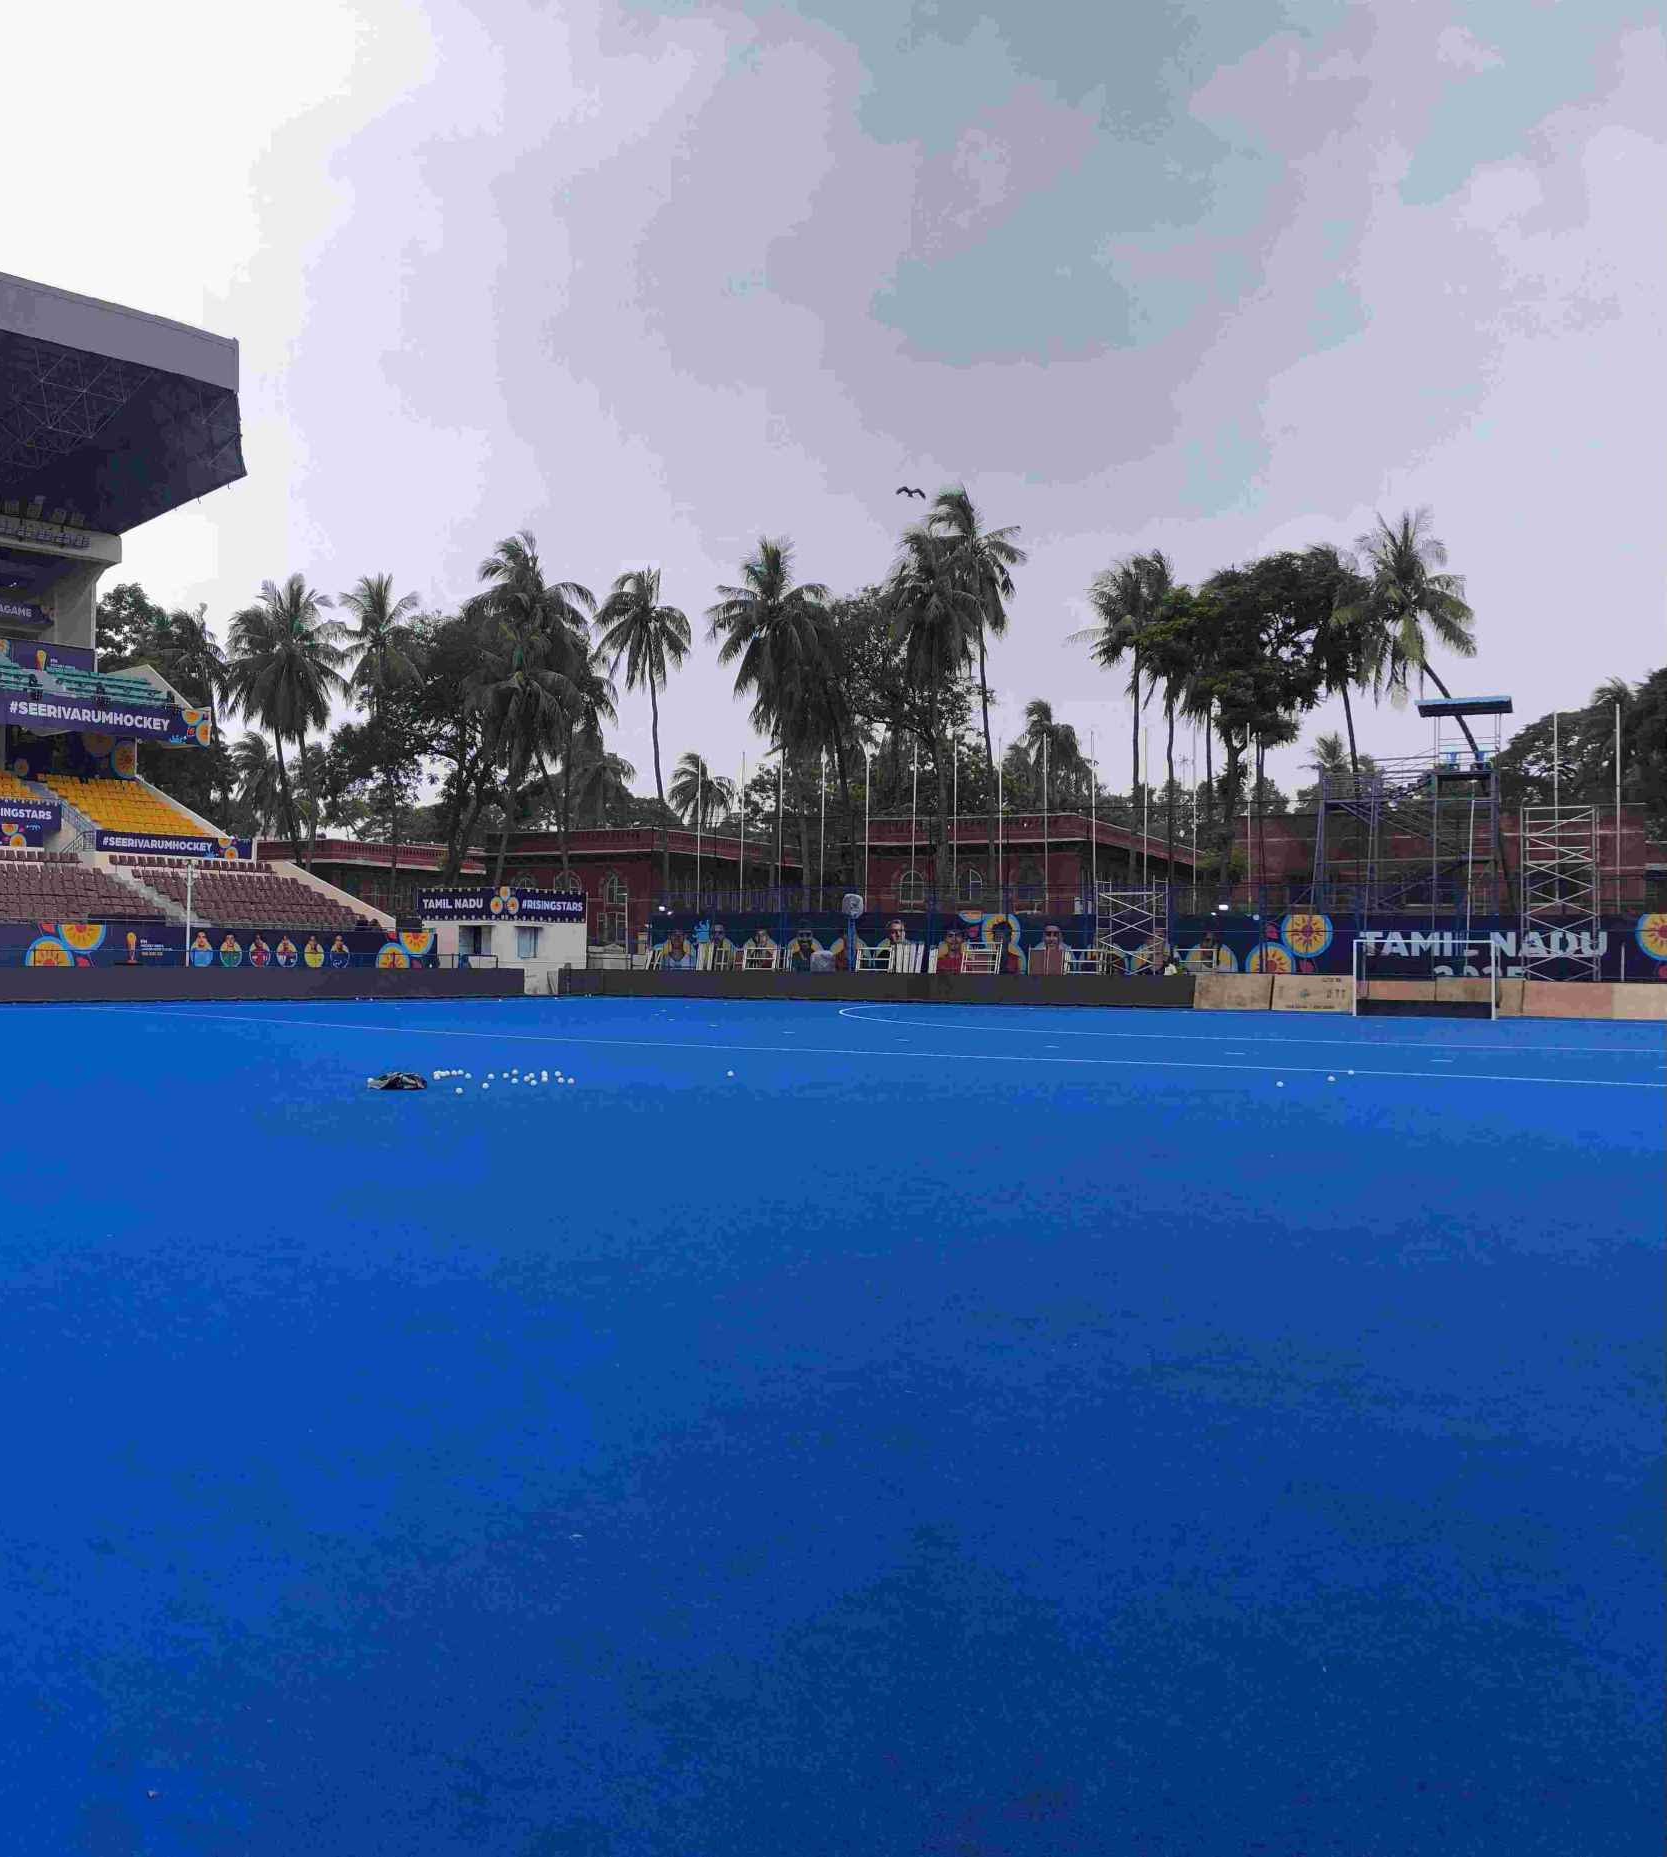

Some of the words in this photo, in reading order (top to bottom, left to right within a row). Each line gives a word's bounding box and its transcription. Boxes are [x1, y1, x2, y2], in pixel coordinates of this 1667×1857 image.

[9, 700, 171, 732] #SEERIVARUMHOCKEY
[102, 835, 213, 853] #SEERIVARUMHOCKEY
[422, 898, 452, 909] TAMIL
[454, 898, 483, 909] NADU
[521, 899, 584, 912] #RISINGSTARS
[1490, 931, 1609, 957] NADU
